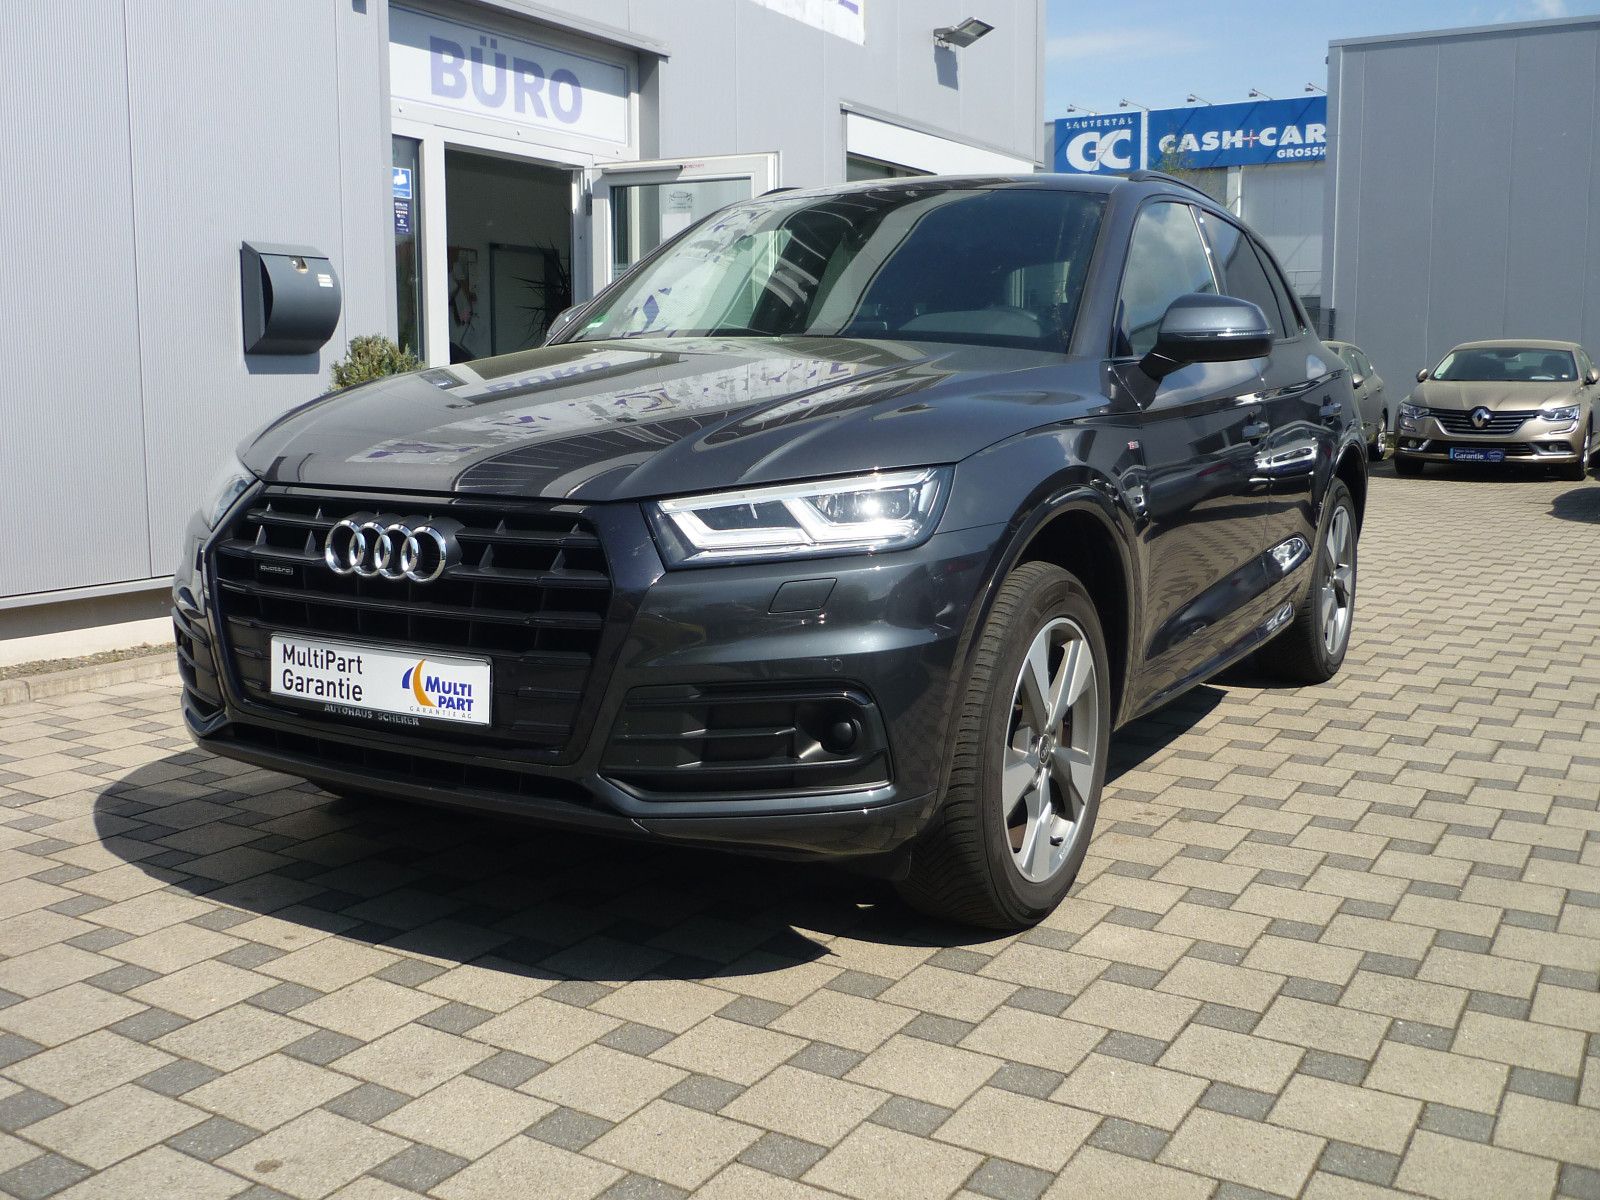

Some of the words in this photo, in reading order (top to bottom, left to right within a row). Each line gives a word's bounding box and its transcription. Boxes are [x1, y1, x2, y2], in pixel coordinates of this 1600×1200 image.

[430, 35, 583, 124] BÜRO
[1066, 117, 1133, 130] LAUTERTAL
[283, 643, 363, 675] MultiPart
[282, 668, 363, 702] Garantie
[425, 675, 472, 697] MULTI
[324, 704, 373, 719] AUTOHAUS
[410, 705, 456, 717] GARANTIE
[438, 695, 474, 712] PART
